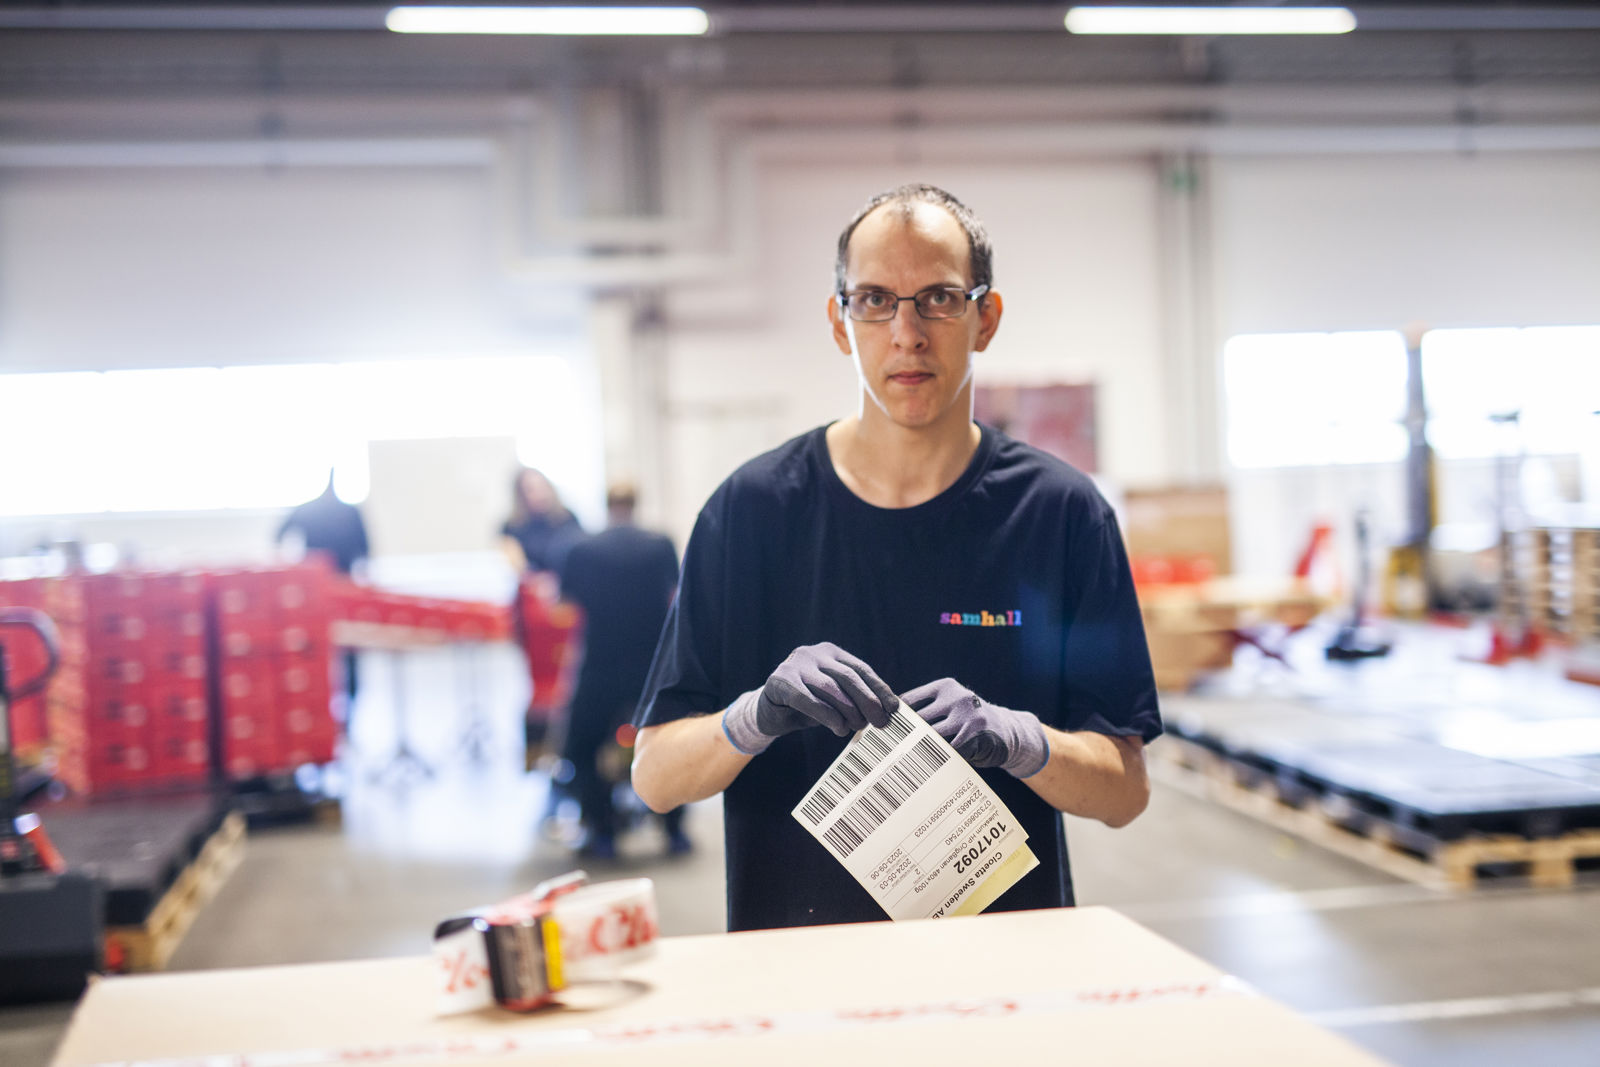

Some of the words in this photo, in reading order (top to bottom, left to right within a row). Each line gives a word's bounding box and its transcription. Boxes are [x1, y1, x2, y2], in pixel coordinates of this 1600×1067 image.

[940, 610, 1021, 626] samhall
[956, 789, 983, 815] 2234683
[975, 809, 1000, 835] Juleskum
[953, 821, 1007, 874] 1017092
[967, 833, 977, 844] HP
[870, 848, 903, 881] 2023-09-06
[879, 857, 912, 890] 2024-05-03
[974, 851, 1003, 879] Cloetta
[944, 877, 976, 909] Sweden
